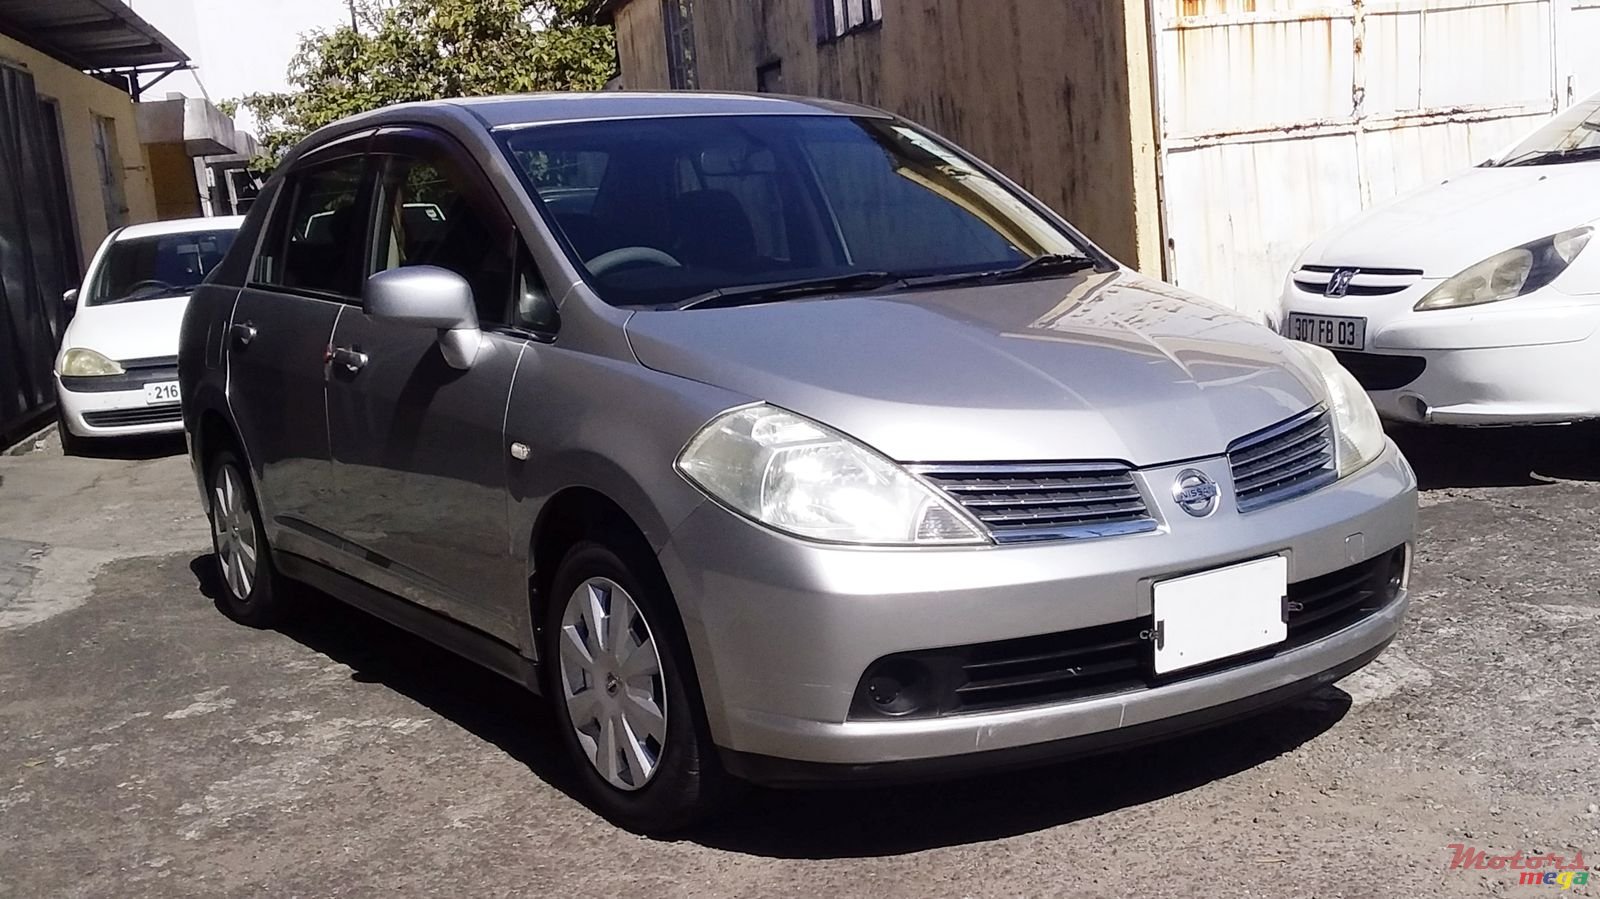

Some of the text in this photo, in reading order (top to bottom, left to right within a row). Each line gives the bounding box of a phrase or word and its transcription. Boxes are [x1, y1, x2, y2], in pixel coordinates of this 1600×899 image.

[1295, 318, 1355, 345] 307 FB 03
[154, 384, 179, 399] 216
